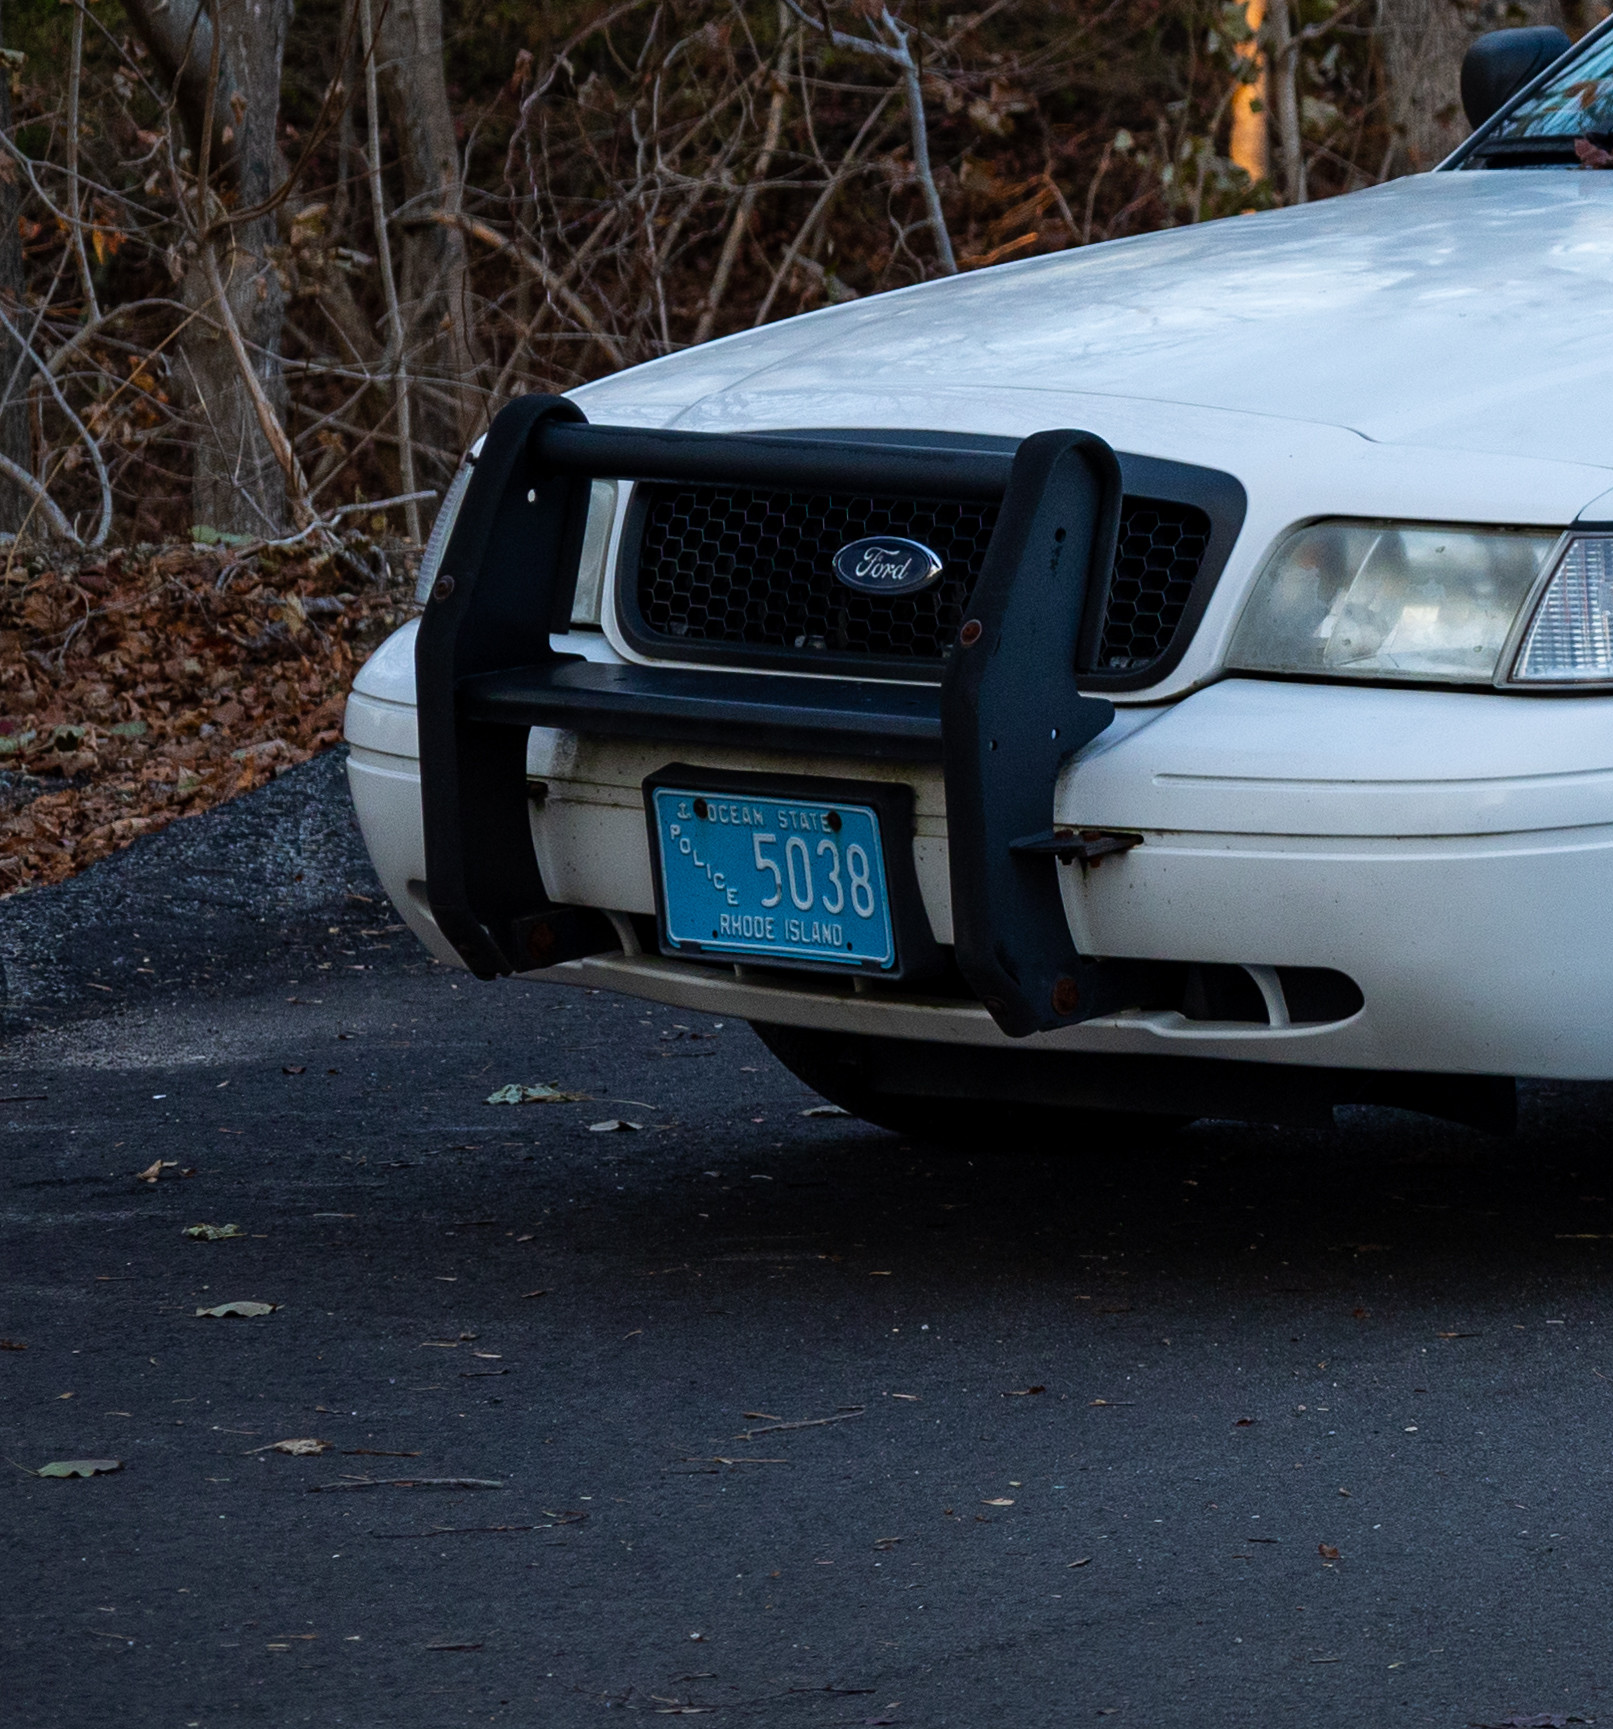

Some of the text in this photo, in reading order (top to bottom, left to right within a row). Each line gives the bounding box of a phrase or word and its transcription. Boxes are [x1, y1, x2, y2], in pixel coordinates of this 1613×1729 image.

[855, 546, 913, 580] Ford
[707, 803, 833, 834] OCEAN STATE
[669, 824, 740, 906] POLICE
[752, 833, 875, 919] 5038
[719, 913, 843, 947] RHODE ISLAND
